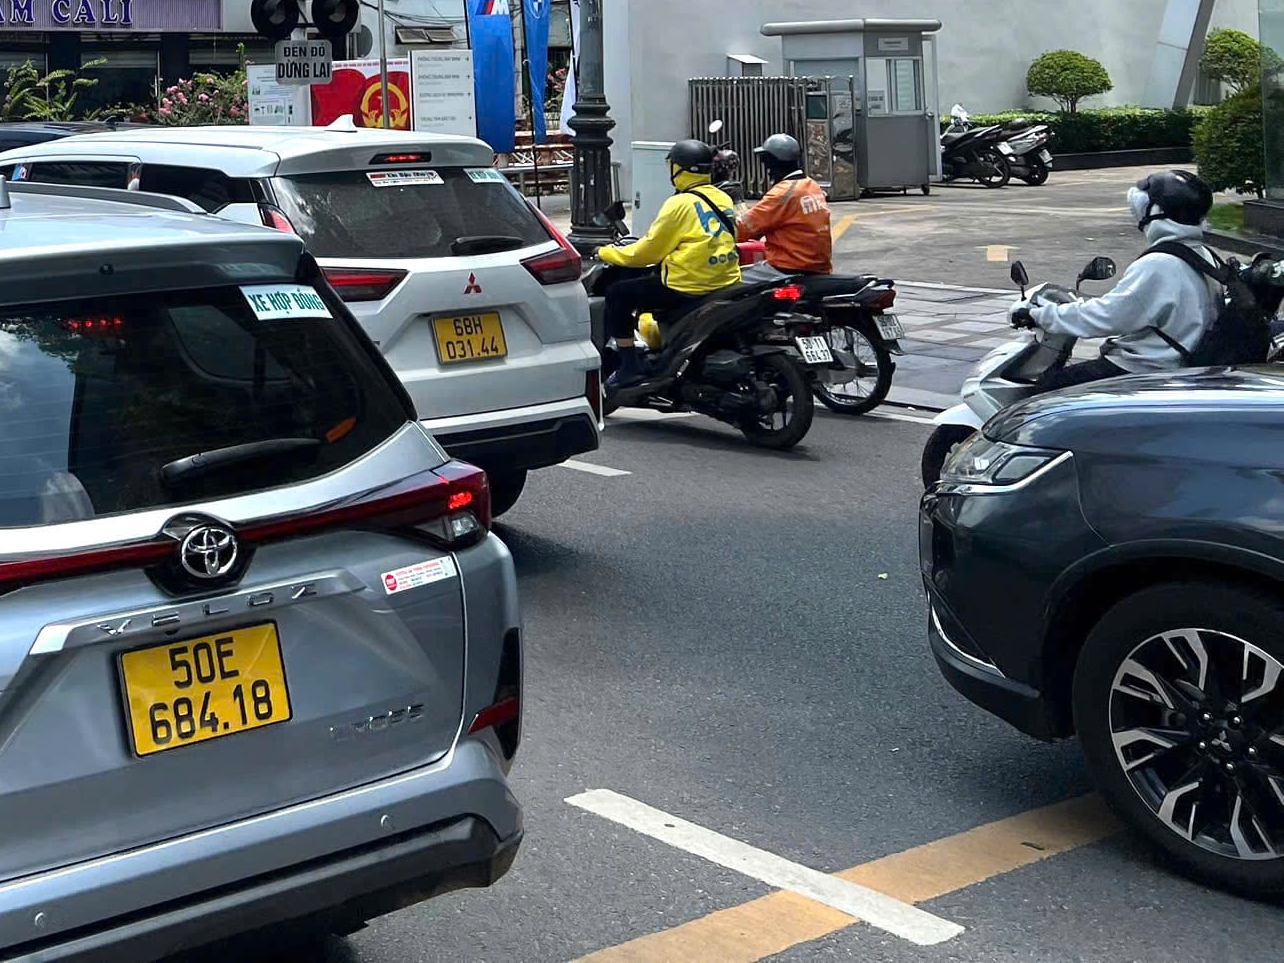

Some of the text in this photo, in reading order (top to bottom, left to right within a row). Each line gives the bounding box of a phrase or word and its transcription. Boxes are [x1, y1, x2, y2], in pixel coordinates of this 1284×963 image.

[278, 59, 309, 78] DỪNG
[248, 288, 325, 314] XE HỢP ĐỒNG
[453, 316, 483, 336] 68H
[446, 336, 498, 359] 031.44
[97, 583, 317, 636] VELOZ
[168, 637, 240, 689] 50E
[149, 679, 273, 746] 684.18
